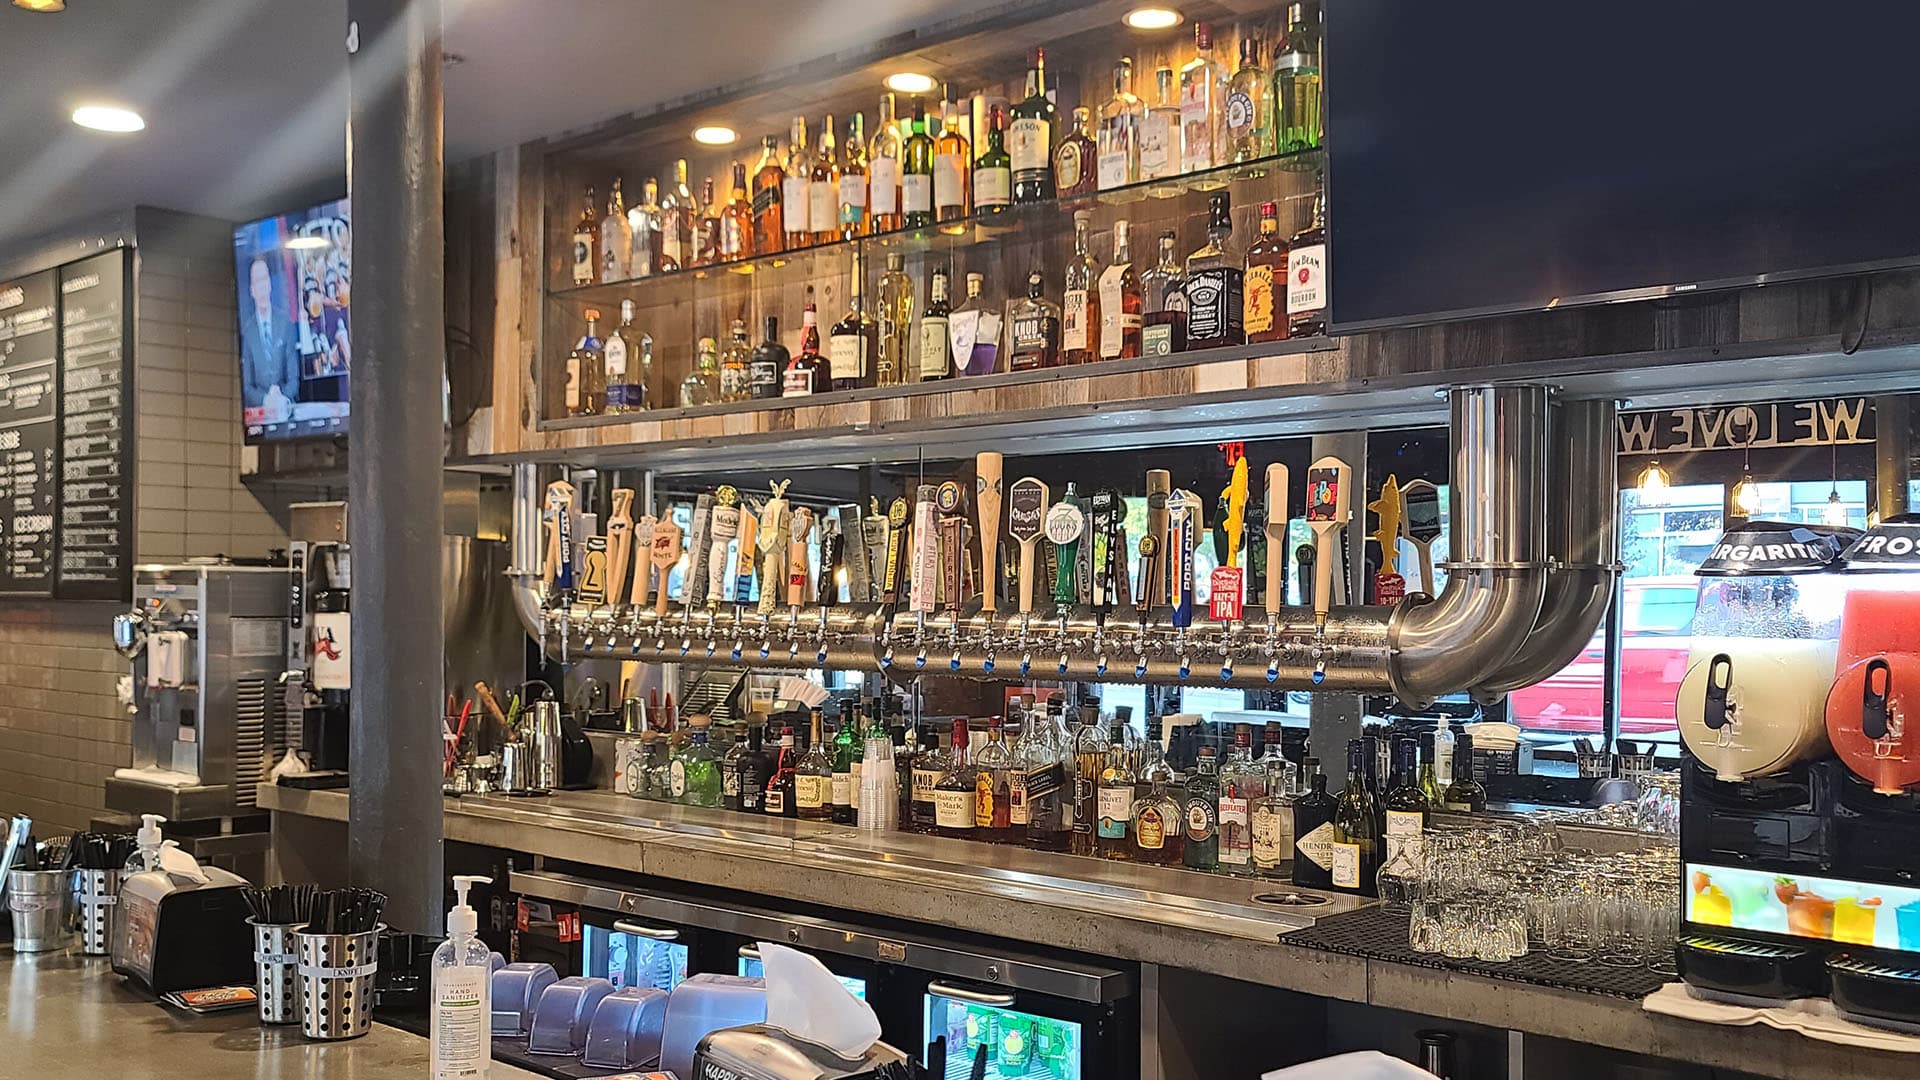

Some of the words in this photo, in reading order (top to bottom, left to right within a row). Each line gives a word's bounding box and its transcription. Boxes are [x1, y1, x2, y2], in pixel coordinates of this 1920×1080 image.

[1014, 319, 1038, 338] KNOB
[1184, 518, 1194, 551] CITY
[1104, 509, 1118, 602] ELYSIAN
[1183, 553, 1192, 591] PORT
[1216, 601, 1233, 618] IPA
[913, 775, 933, 786] KNOB
[936, 793, 964, 801] Maker's
[942, 802, 964, 810] Mark
[1219, 803, 1248, 814] BEEFEATER
[442, 993, 479, 1001] SANITIZER
